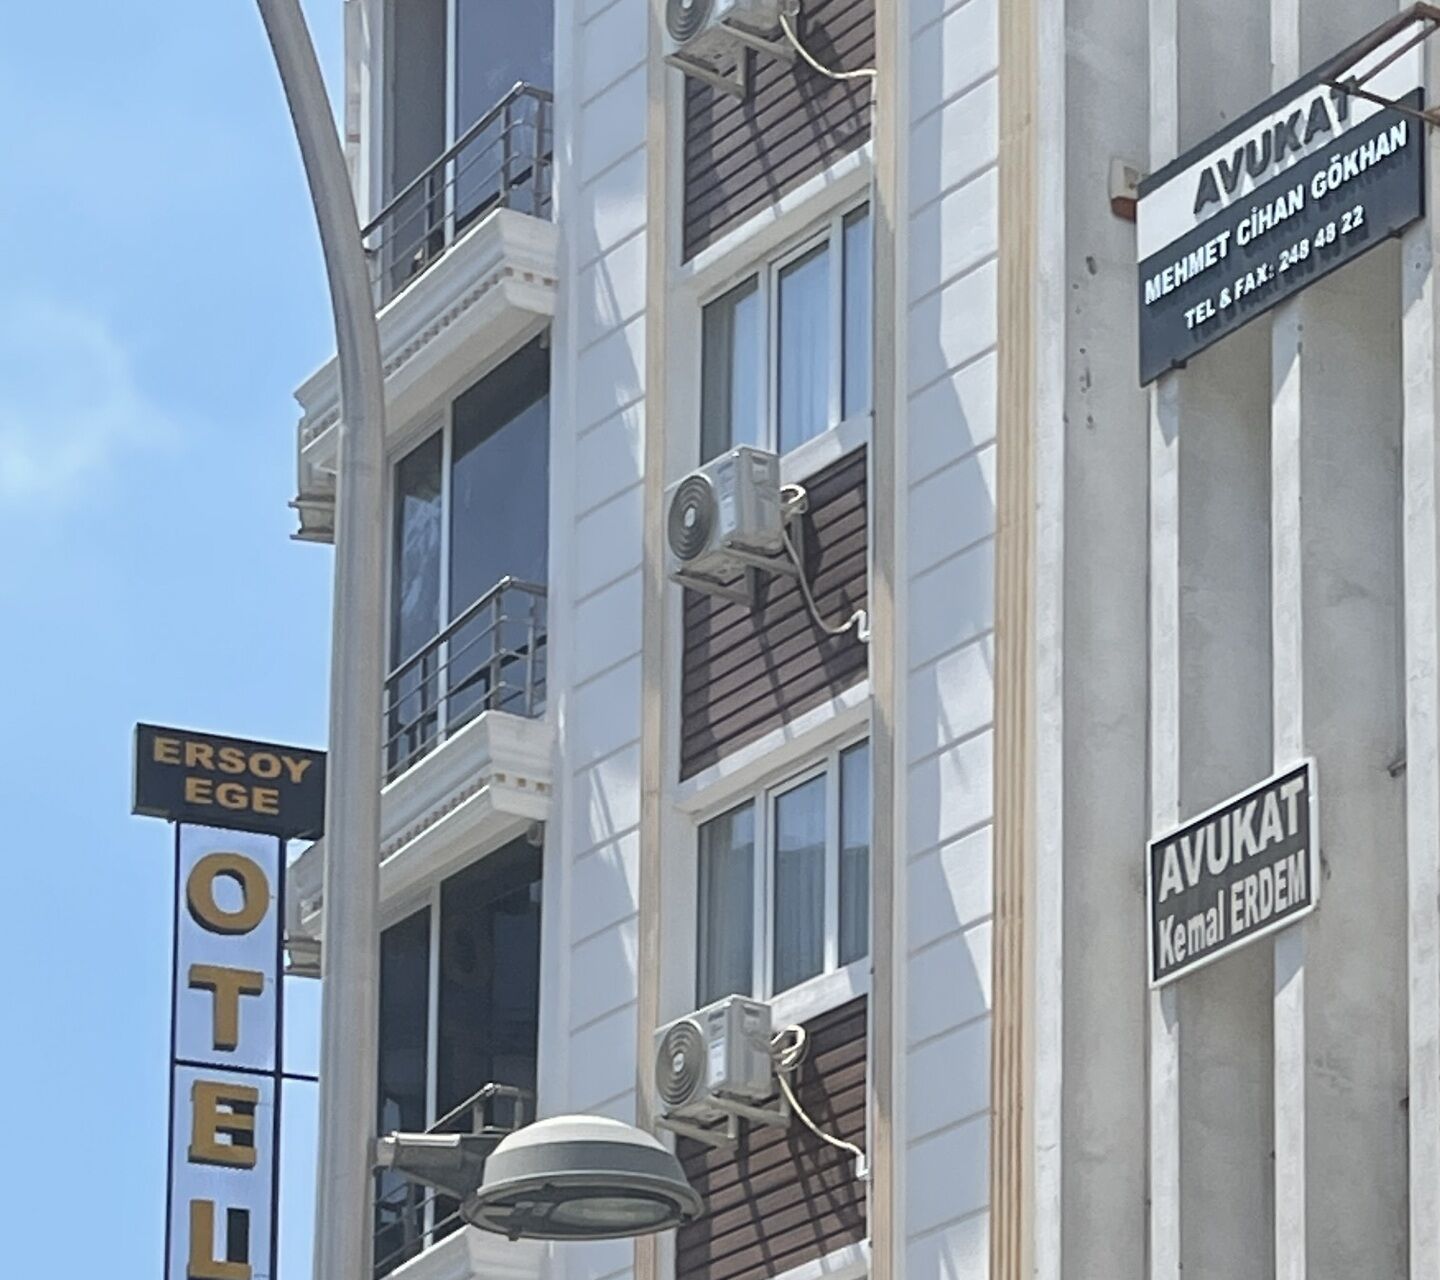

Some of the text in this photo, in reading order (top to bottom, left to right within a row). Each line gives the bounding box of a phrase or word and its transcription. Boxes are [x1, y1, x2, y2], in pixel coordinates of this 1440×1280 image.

[1194, 76, 1359, 214] AVUKAT
[1145, 120, 1409, 305] MEHMET CİHAN GÖKHAN
[1184, 298, 1217, 330] TEL
[1234, 262, 1275, 300] FAX:
[1339, 205, 1365, 235] 22
[154, 735, 313, 786] ERSOY
[184, 776, 280, 816] EGE
[1159, 776, 1305, 903] AVUKAT
[1159, 849, 1306, 969] Kemal ERDEM
